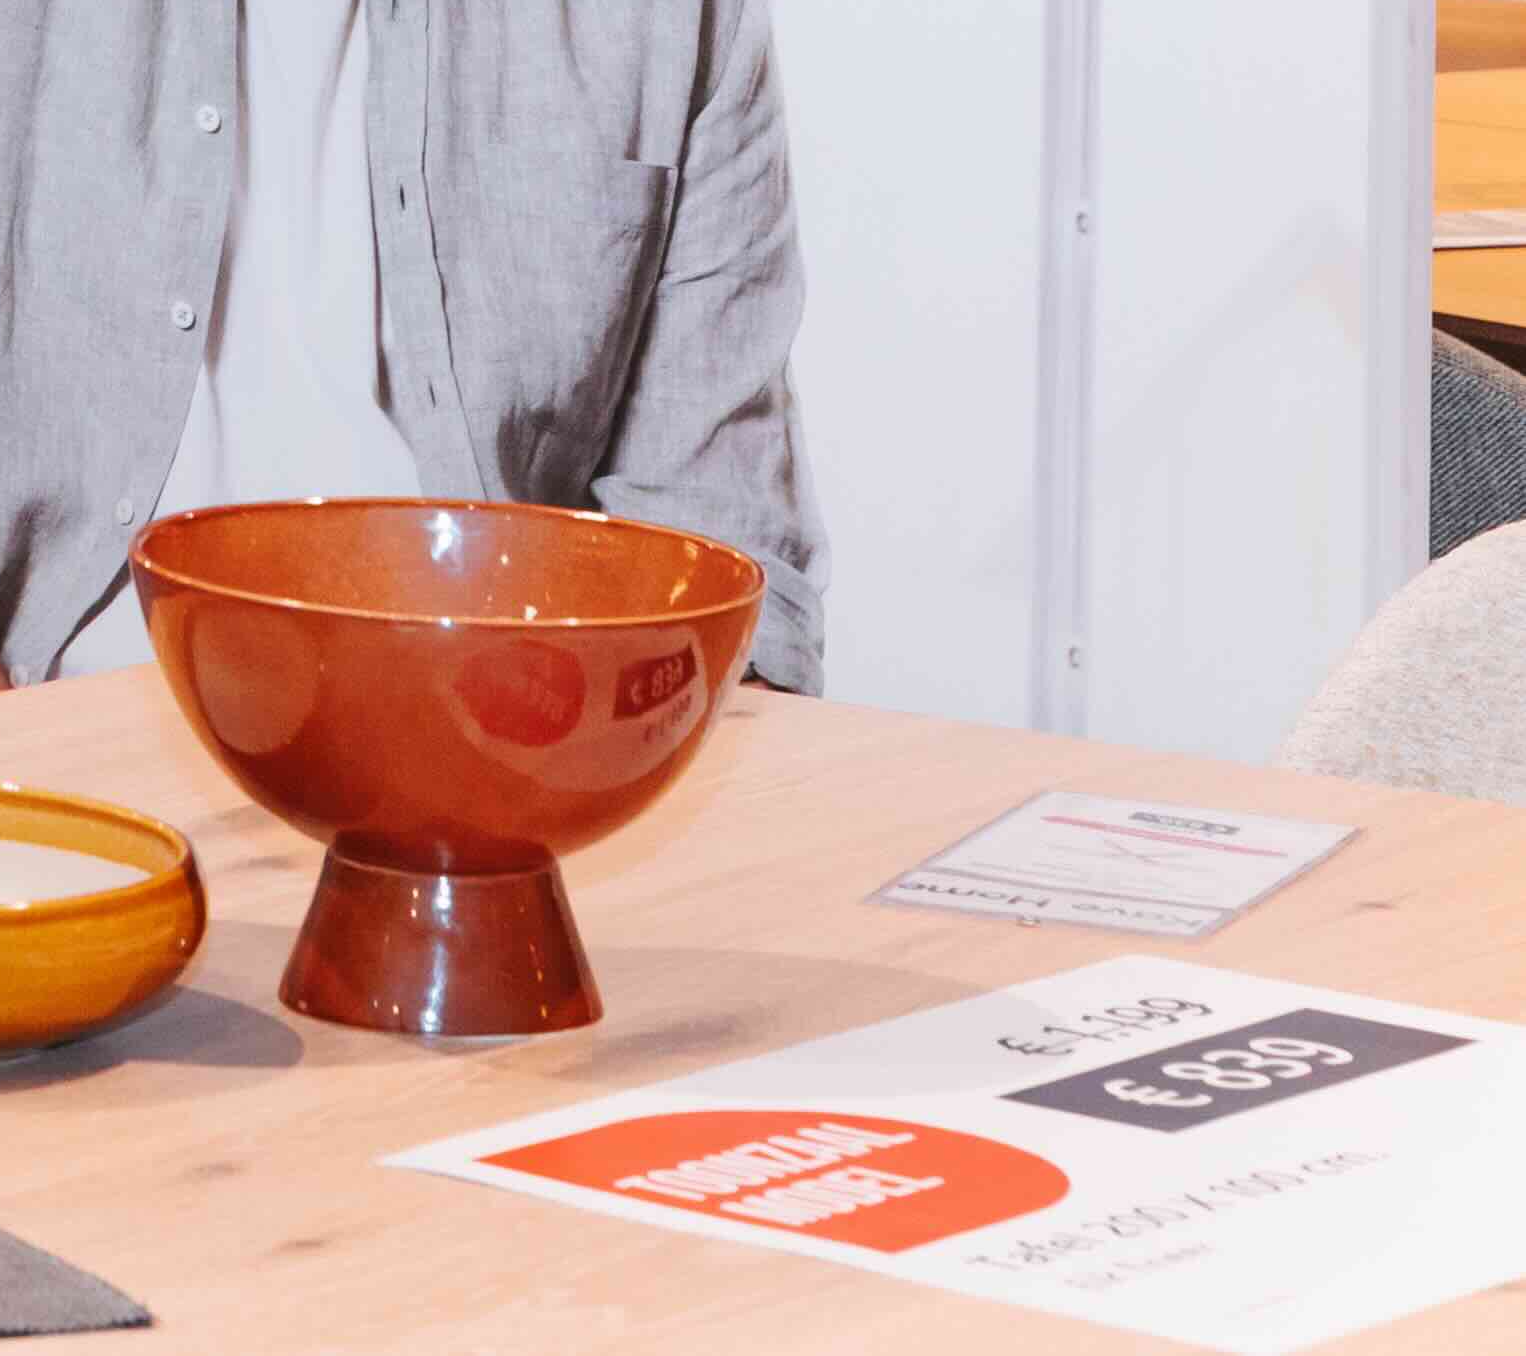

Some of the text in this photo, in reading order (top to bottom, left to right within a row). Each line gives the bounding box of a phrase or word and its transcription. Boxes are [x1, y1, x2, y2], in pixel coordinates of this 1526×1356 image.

[1161, 1036, 1354, 1090] 839
[613, 1121, 917, 1202] TOONZAAL
[719, 1165, 945, 1227] MODEL
